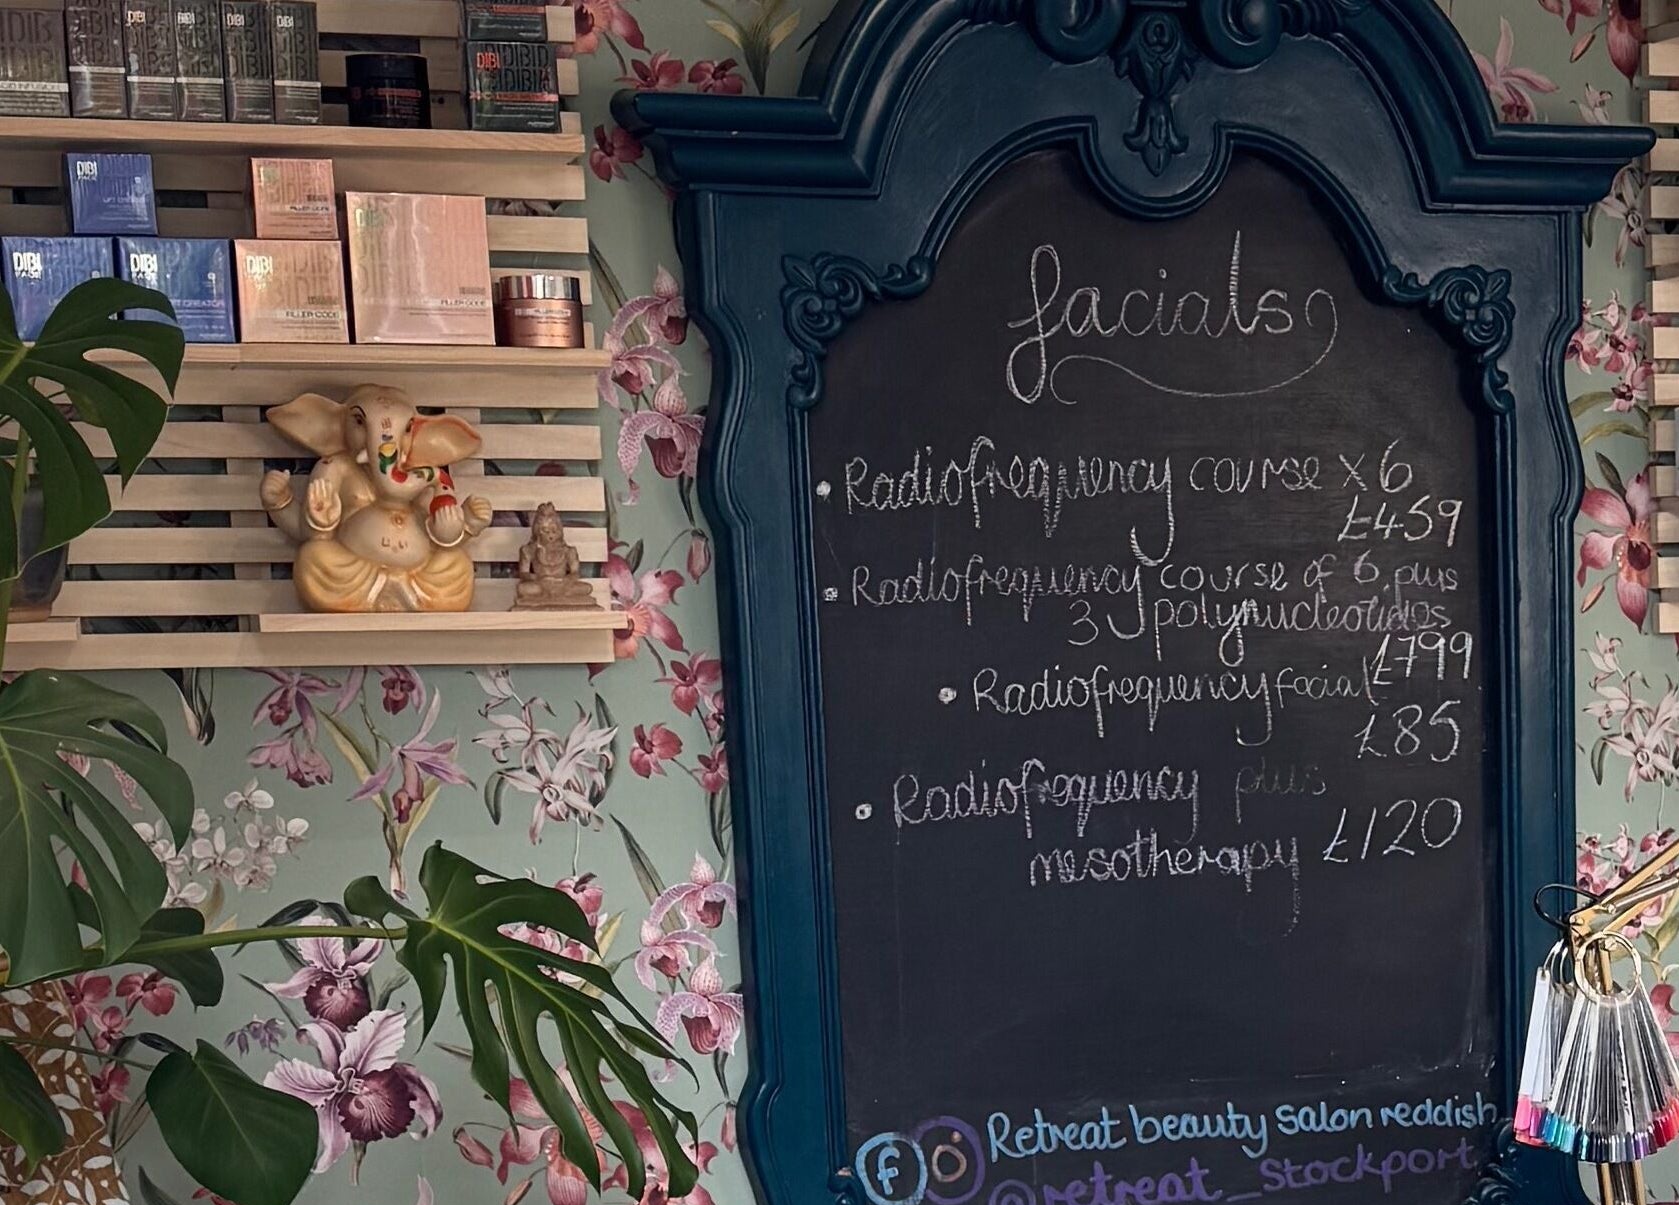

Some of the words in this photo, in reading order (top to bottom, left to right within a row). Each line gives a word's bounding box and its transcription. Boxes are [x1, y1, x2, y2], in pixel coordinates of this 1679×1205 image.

[477, 52, 501, 68] DIBI
[76, 161, 98, 176] DIBI
[13, 252, 42, 272] DIBI
[130, 253, 158, 272] DIBI
[246, 255, 273, 274] DIBI
[845, 435, 1175, 566] Radiofrequency
[1190, 457, 1323, 493] course
[1337, 494, 1463, 547] £459
[853, 554, 1146, 639] Radiofrequency
[1160, 561, 1289, 592] course
[1303, 553, 1337, 604] of
[1394, 562, 1460, 610] plus
[1068, 600, 1099, 646] 3
[1154, 592, 1453, 667] polynucleotides
[1370, 631, 1474, 686] £799
[973, 664, 1274, 746] Radiofrequency
[1275, 656, 1378, 706] facial
[1356, 702, 1462, 762] £85
[1235, 757, 1328, 824] plus
[1322, 797, 1463, 864] £120
[1029, 827, 1300, 937] mesotherapy
[987, 1108, 1128, 1163] Retreat
[1129, 1102, 1269, 1159] beauty
[1381, 1092, 1498, 1128] reddish
